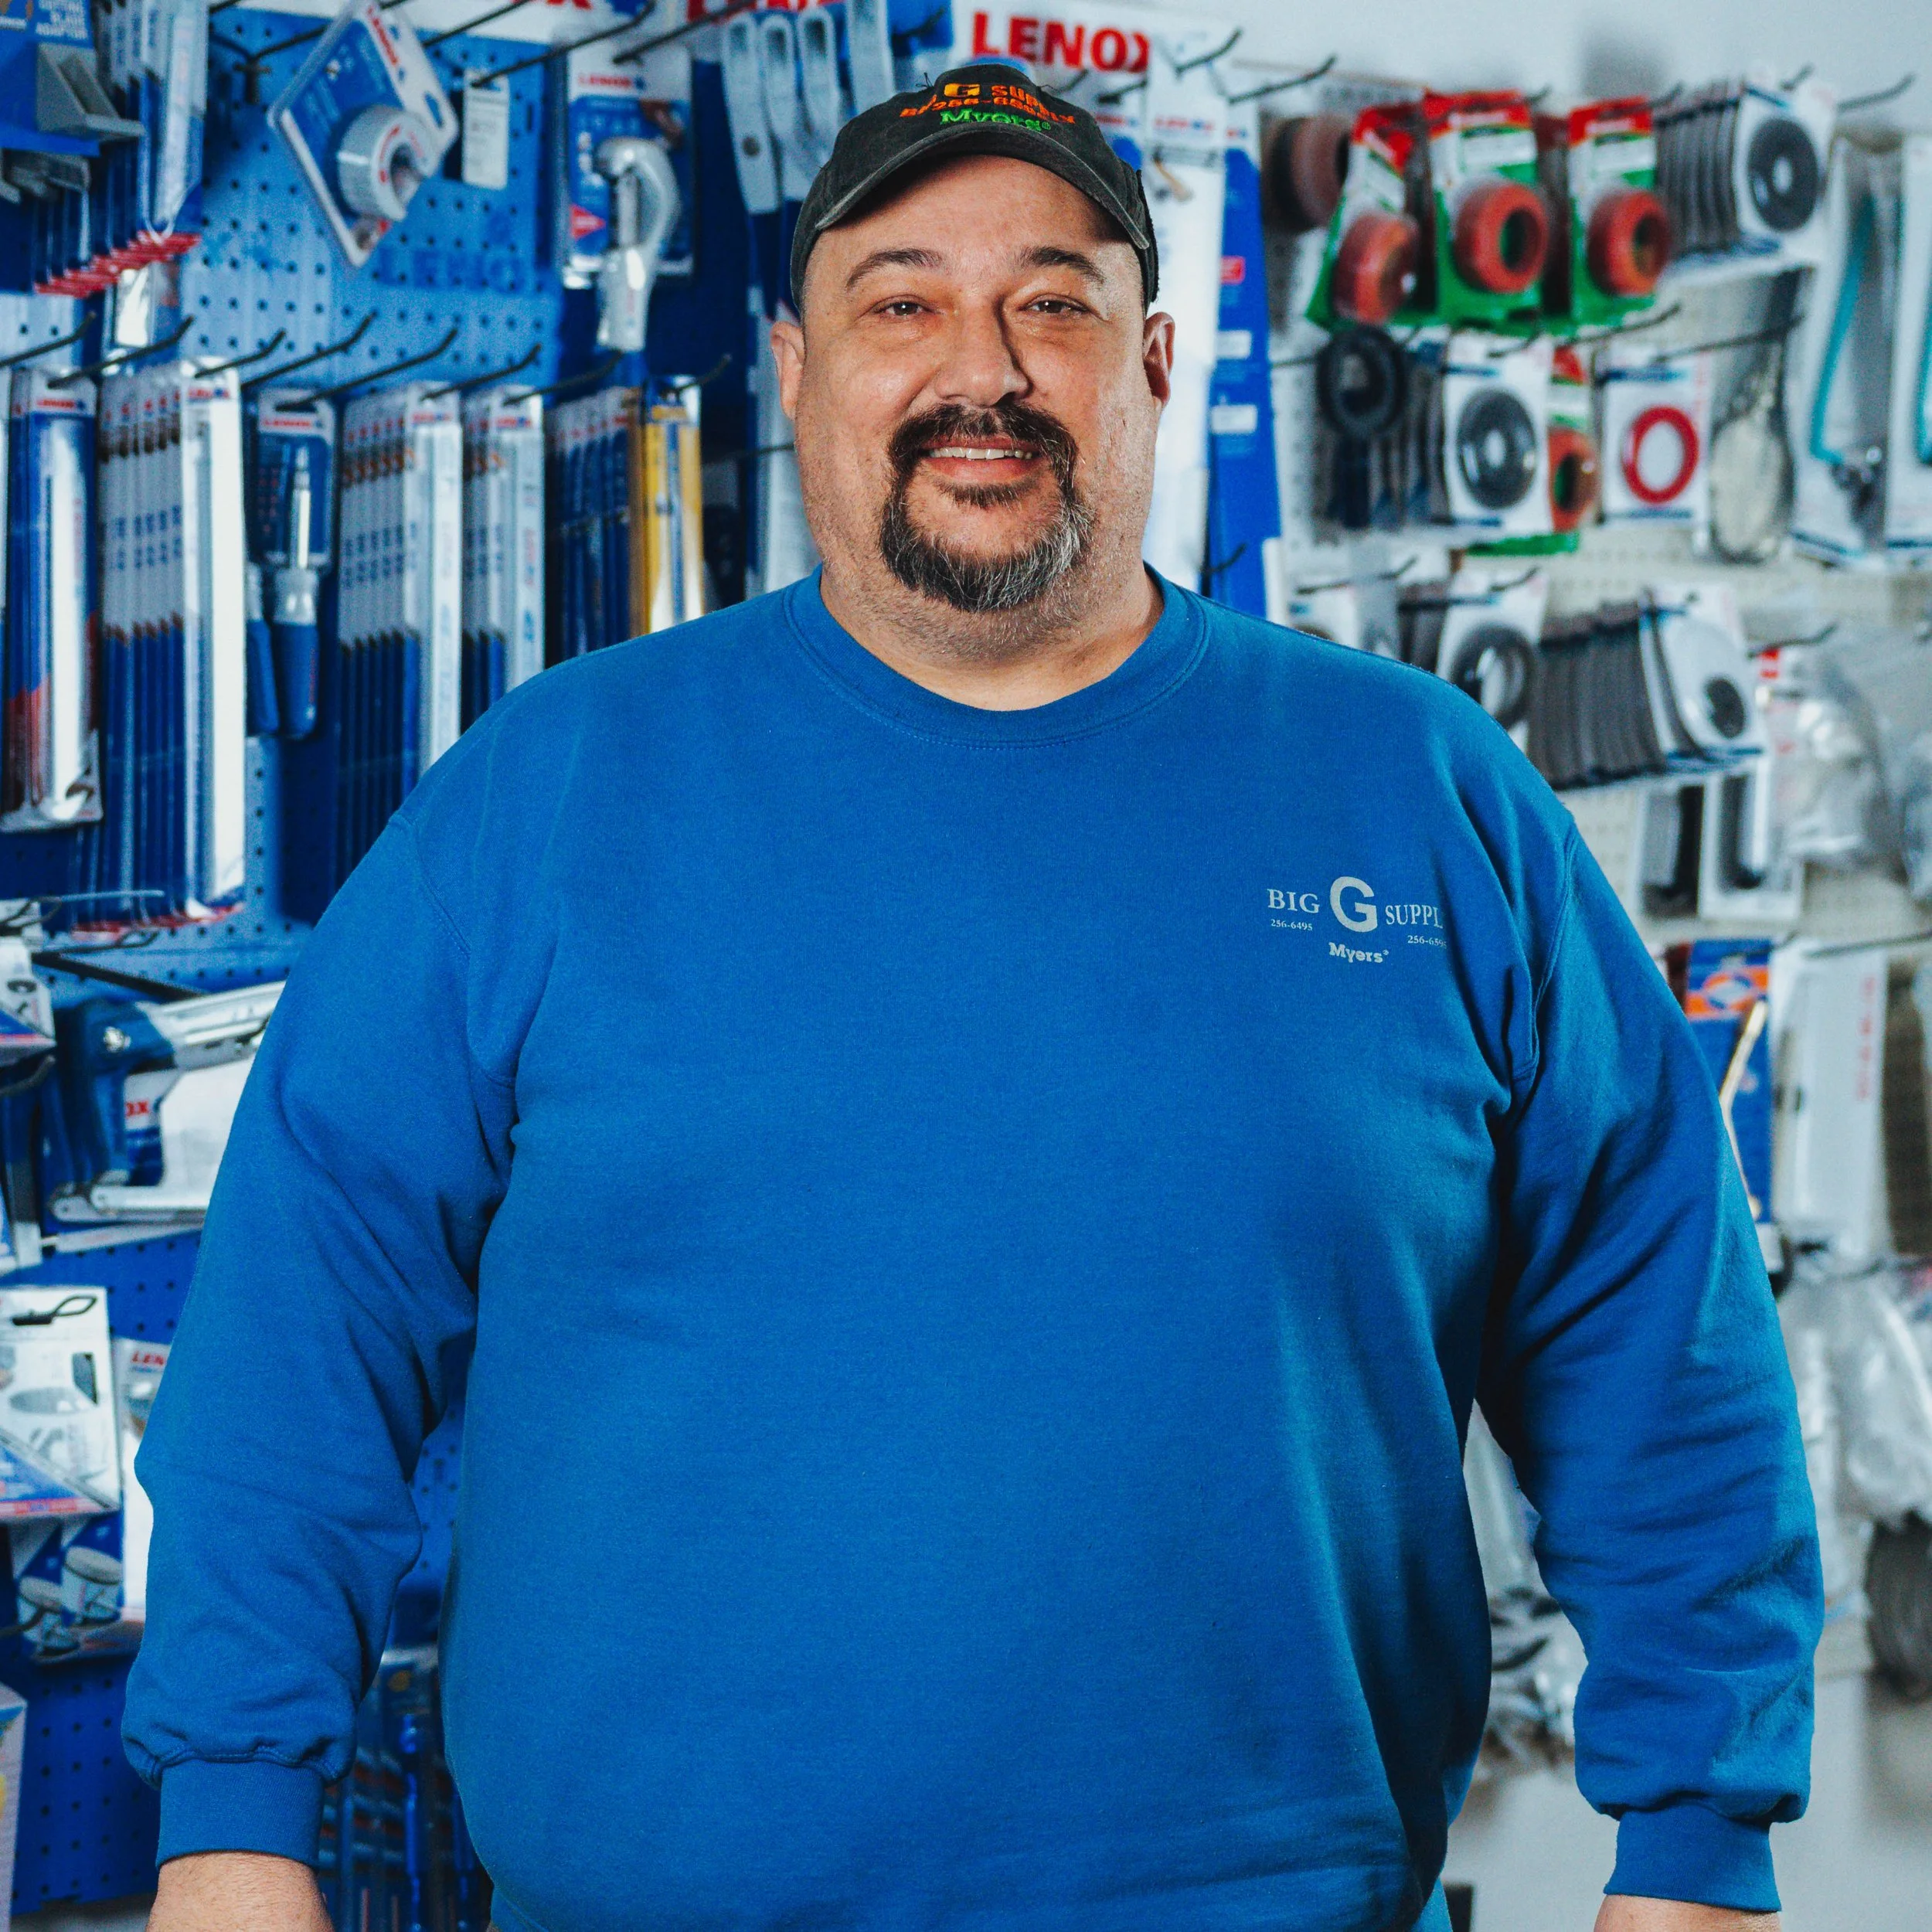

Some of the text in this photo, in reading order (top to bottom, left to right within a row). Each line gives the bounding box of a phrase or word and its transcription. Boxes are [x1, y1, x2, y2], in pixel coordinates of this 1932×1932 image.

[944, 83, 981, 98] G
[1267, 889, 1320, 914] BIG
[1329, 876, 1378, 933] G
[1270, 918, 1313, 932] 256-6495
